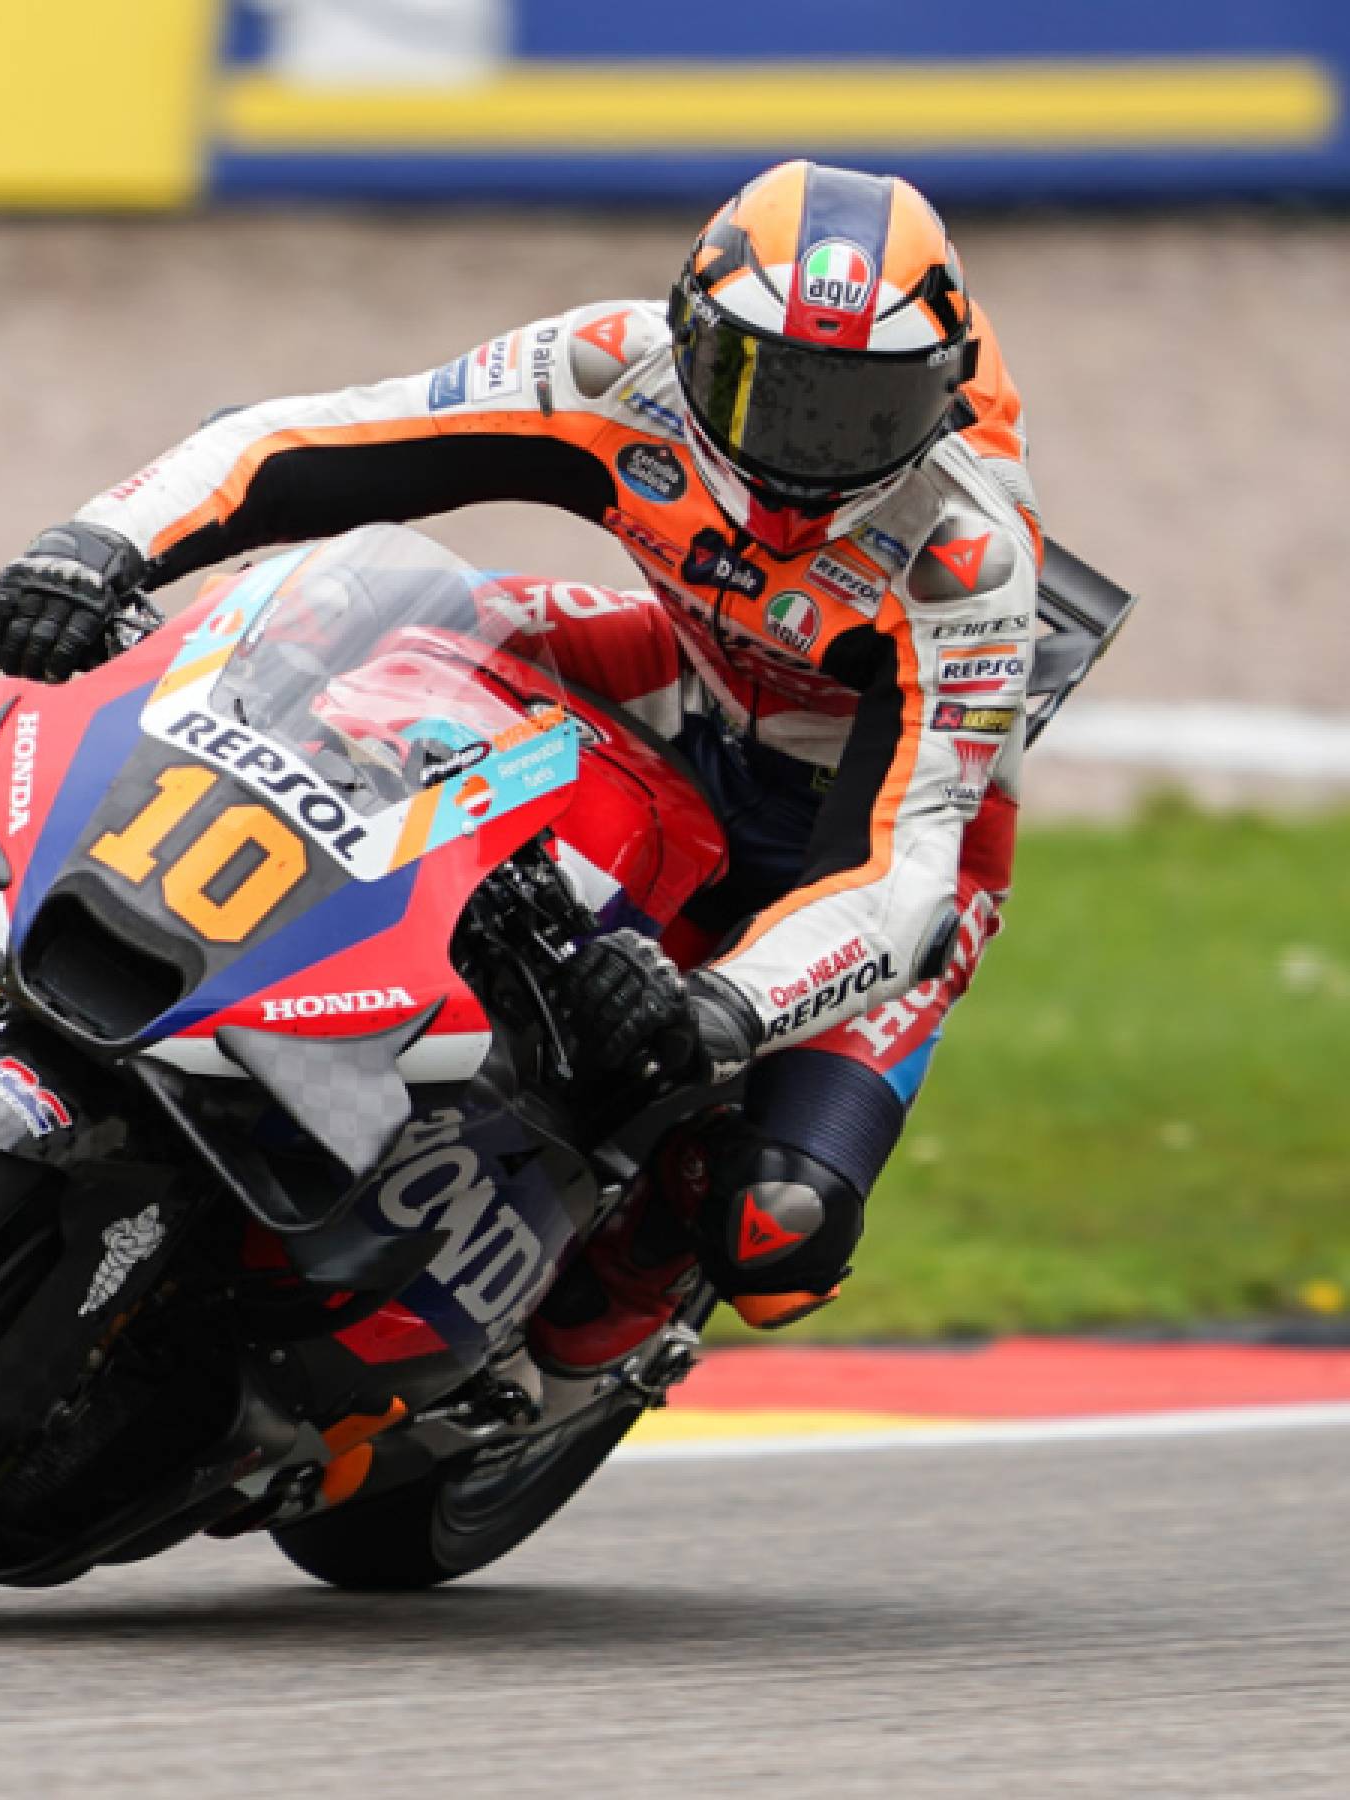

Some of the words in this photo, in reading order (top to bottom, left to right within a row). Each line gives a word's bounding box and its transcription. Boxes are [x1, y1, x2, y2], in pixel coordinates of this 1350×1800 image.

[809, 278, 861, 306] agv
[9, 711, 40, 836] HONDA
[165, 710, 369, 861] REPSOL
[86, 764, 309, 943] 10
[261, 986, 416, 1022] HONDA
[766, 953, 897, 1042] REPSOL
[807, 936, 867, 987] HEART
